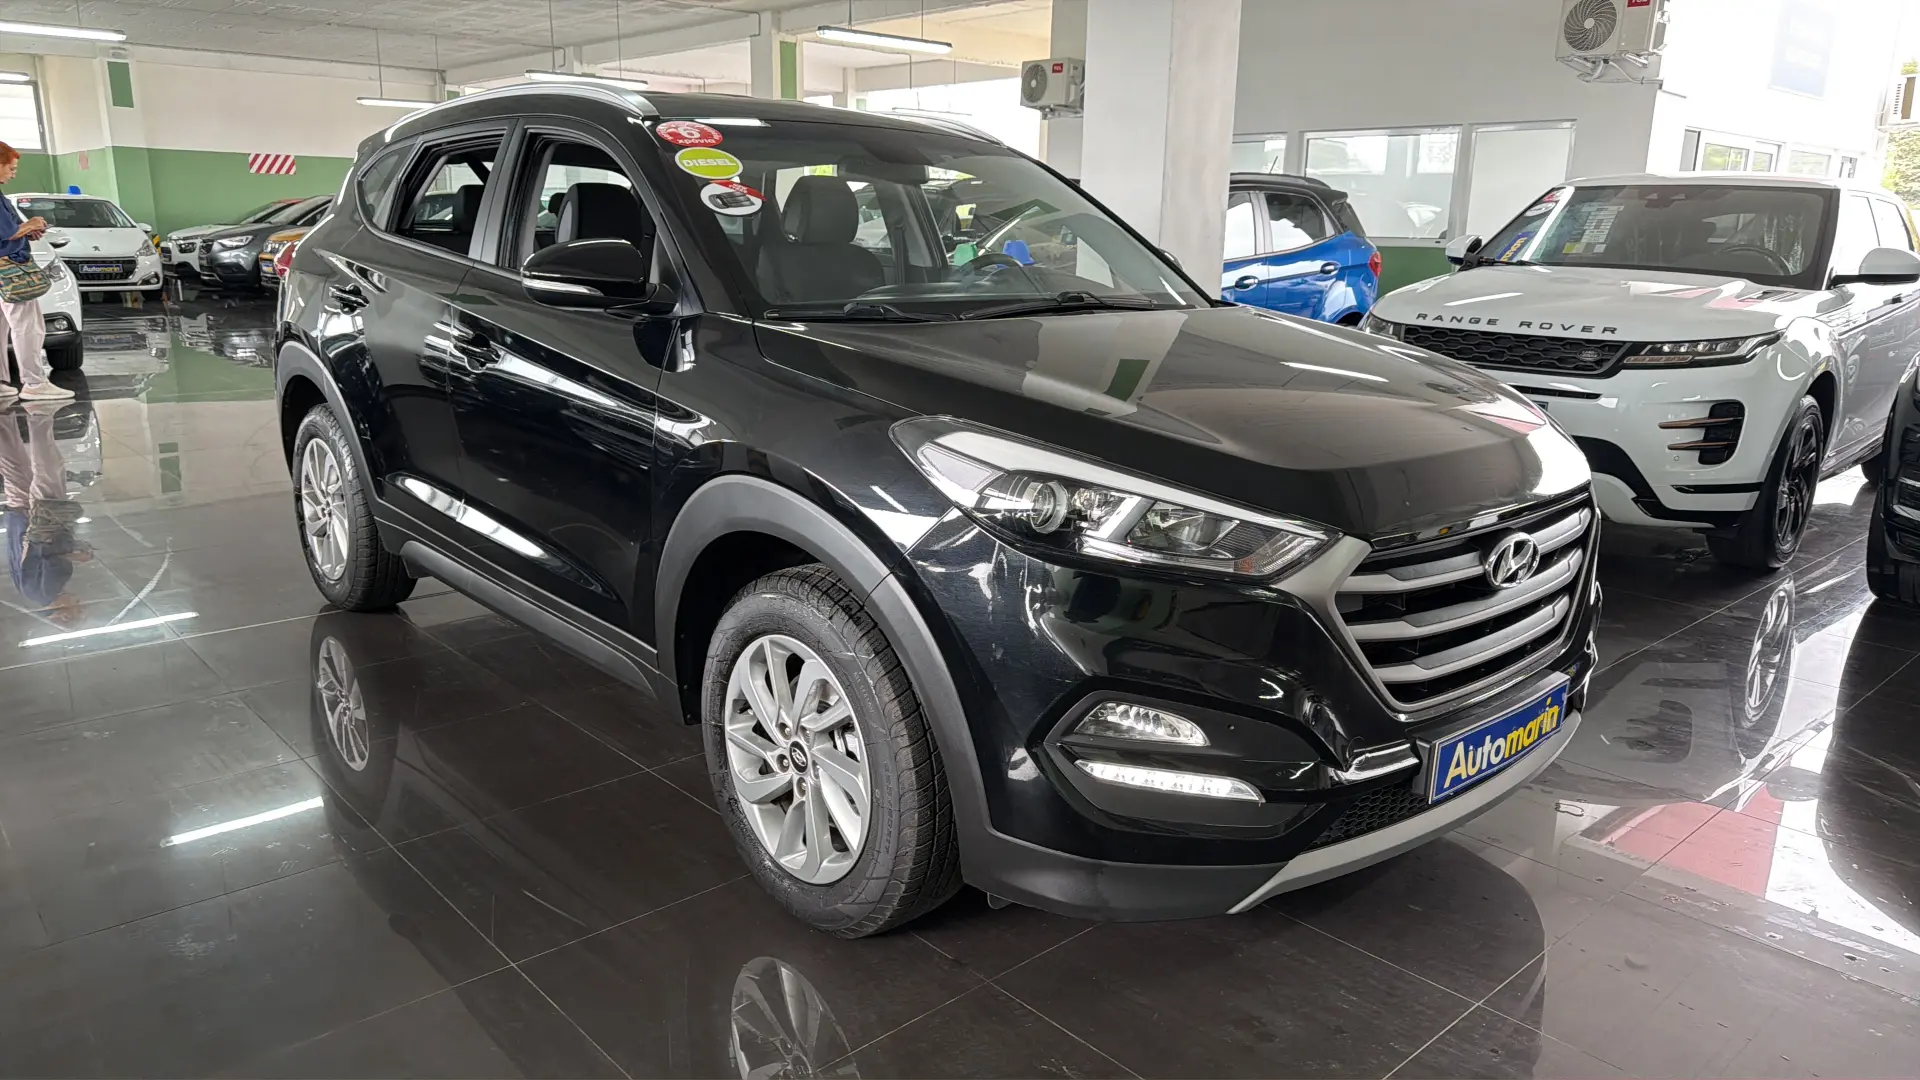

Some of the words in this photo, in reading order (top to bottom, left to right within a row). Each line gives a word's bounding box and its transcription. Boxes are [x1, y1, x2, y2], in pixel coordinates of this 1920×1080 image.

[678, 126, 701, 139] 6
[682, 159, 737, 167] DIESEL
[1416, 313, 1500, 326] RANGE
[1518, 321, 1618, 335] ROVER
[1443, 697, 1560, 789] Automarin
